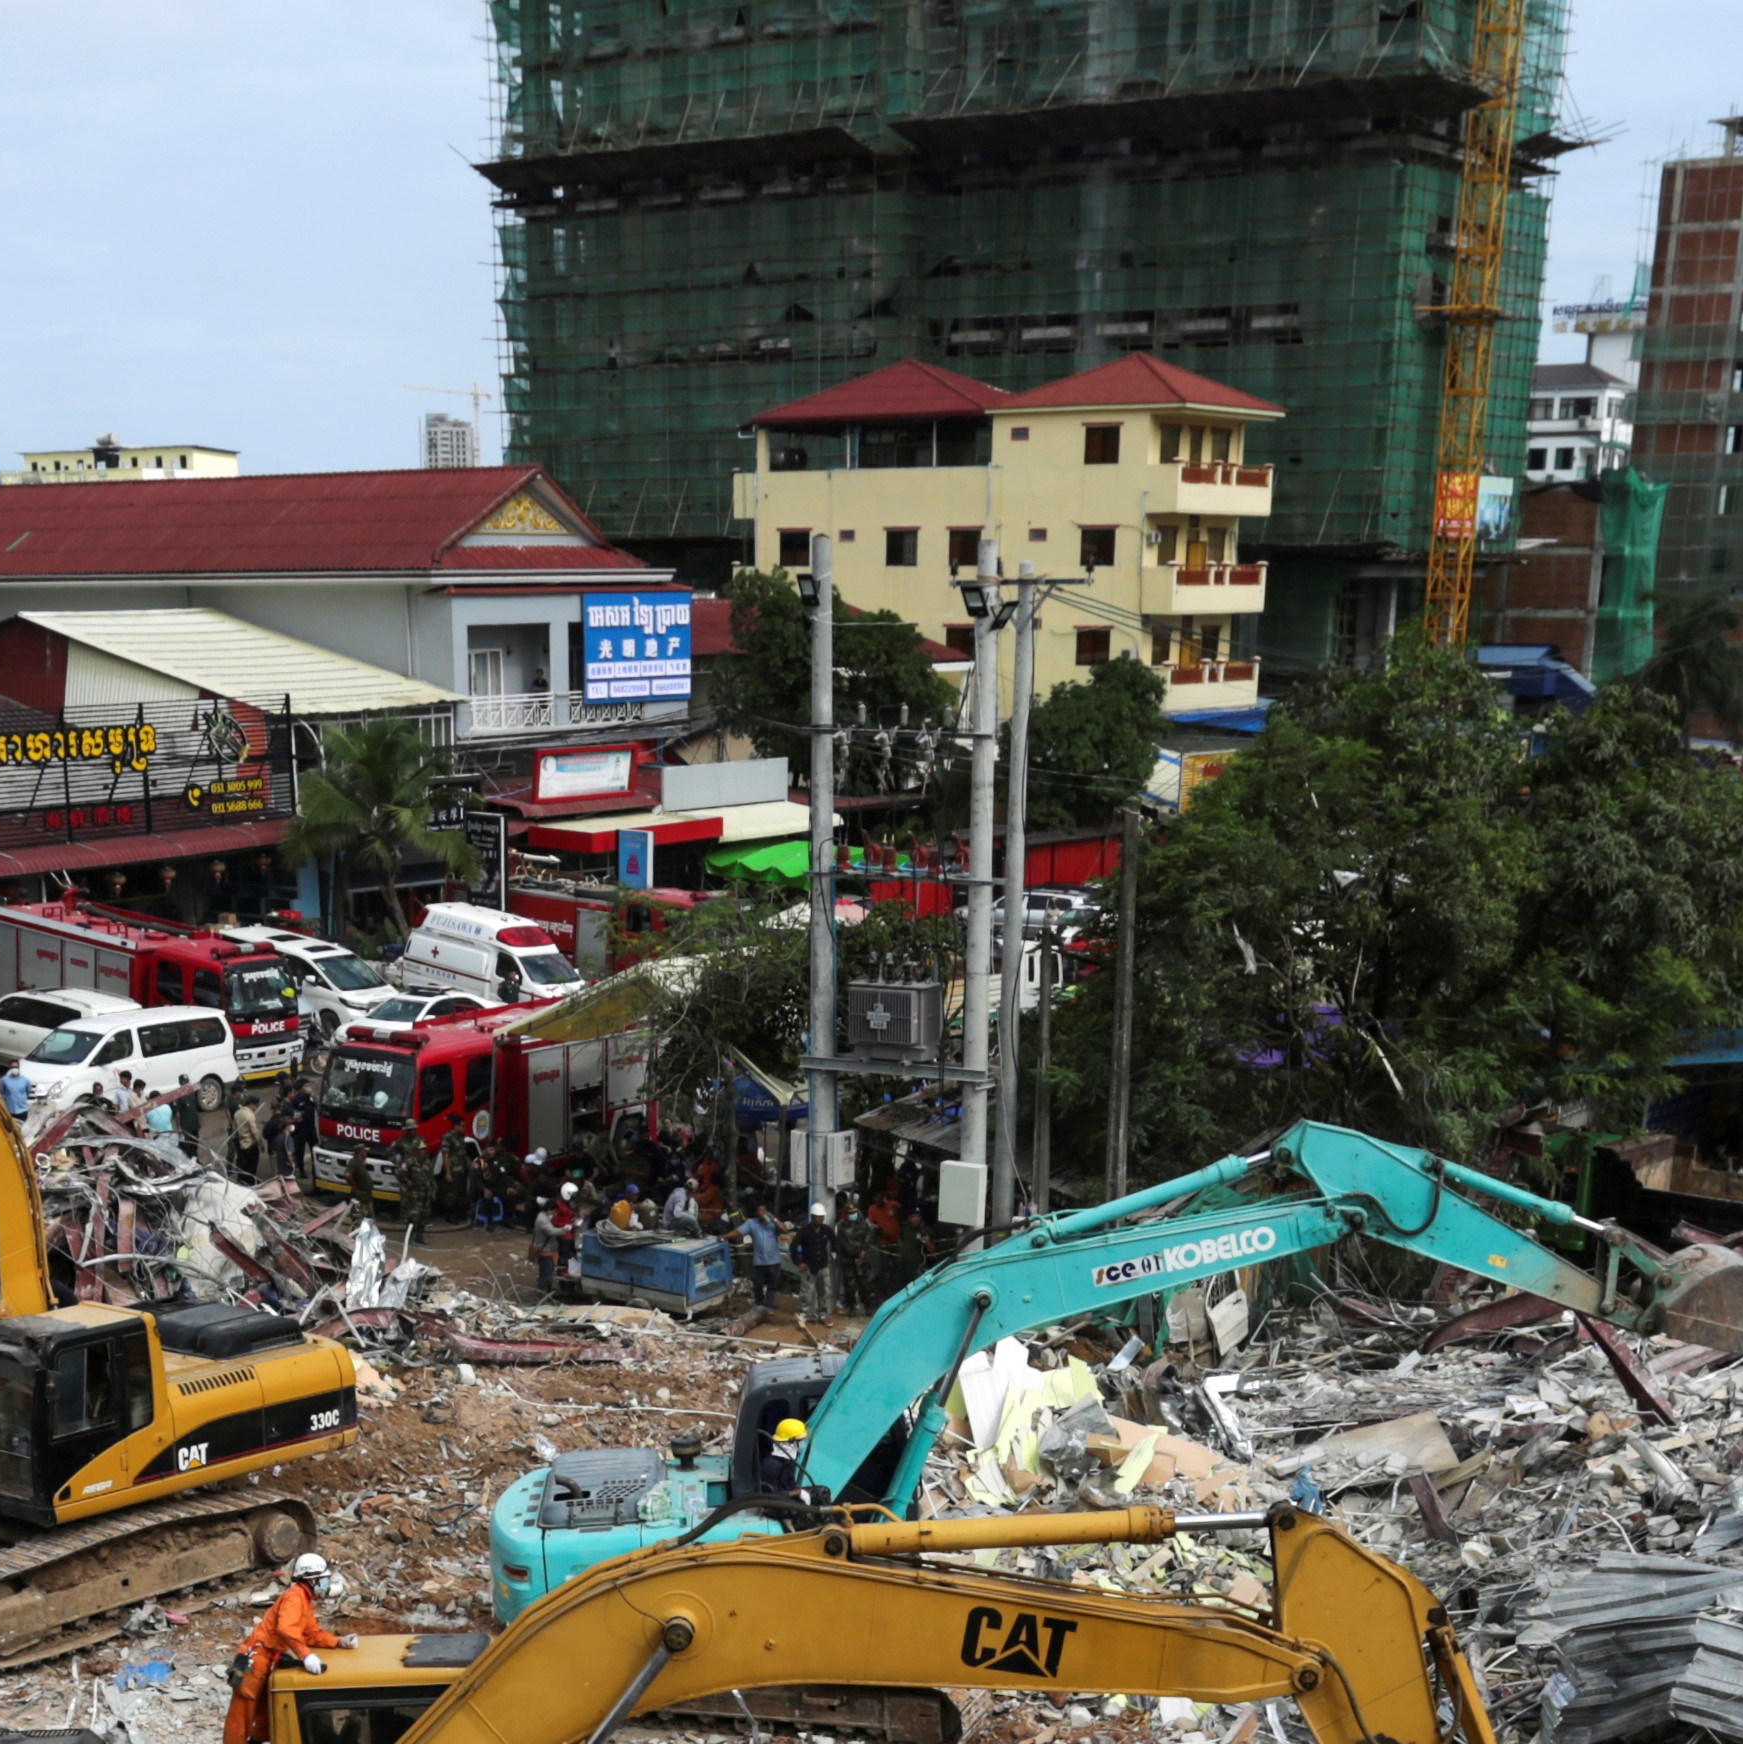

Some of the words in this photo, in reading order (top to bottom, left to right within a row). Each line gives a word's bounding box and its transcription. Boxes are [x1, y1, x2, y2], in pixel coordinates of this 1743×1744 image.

[598, 636, 681, 660] 光明地产
[210, 782, 225, 794] 031
[247, 778, 263, 790] 999
[248, 798, 264, 810] 666
[429, 913, 472, 933] FUJISAWA
[251, 1020, 285, 1035] POLICE
[336, 1123, 381, 1143] POLICE
[1163, 1225, 1277, 1273] KOBELCO
[310, 1409, 340, 1431] 330C
[178, 1441, 210, 1472] CAT
[960, 1605, 1078, 1678] CAT
